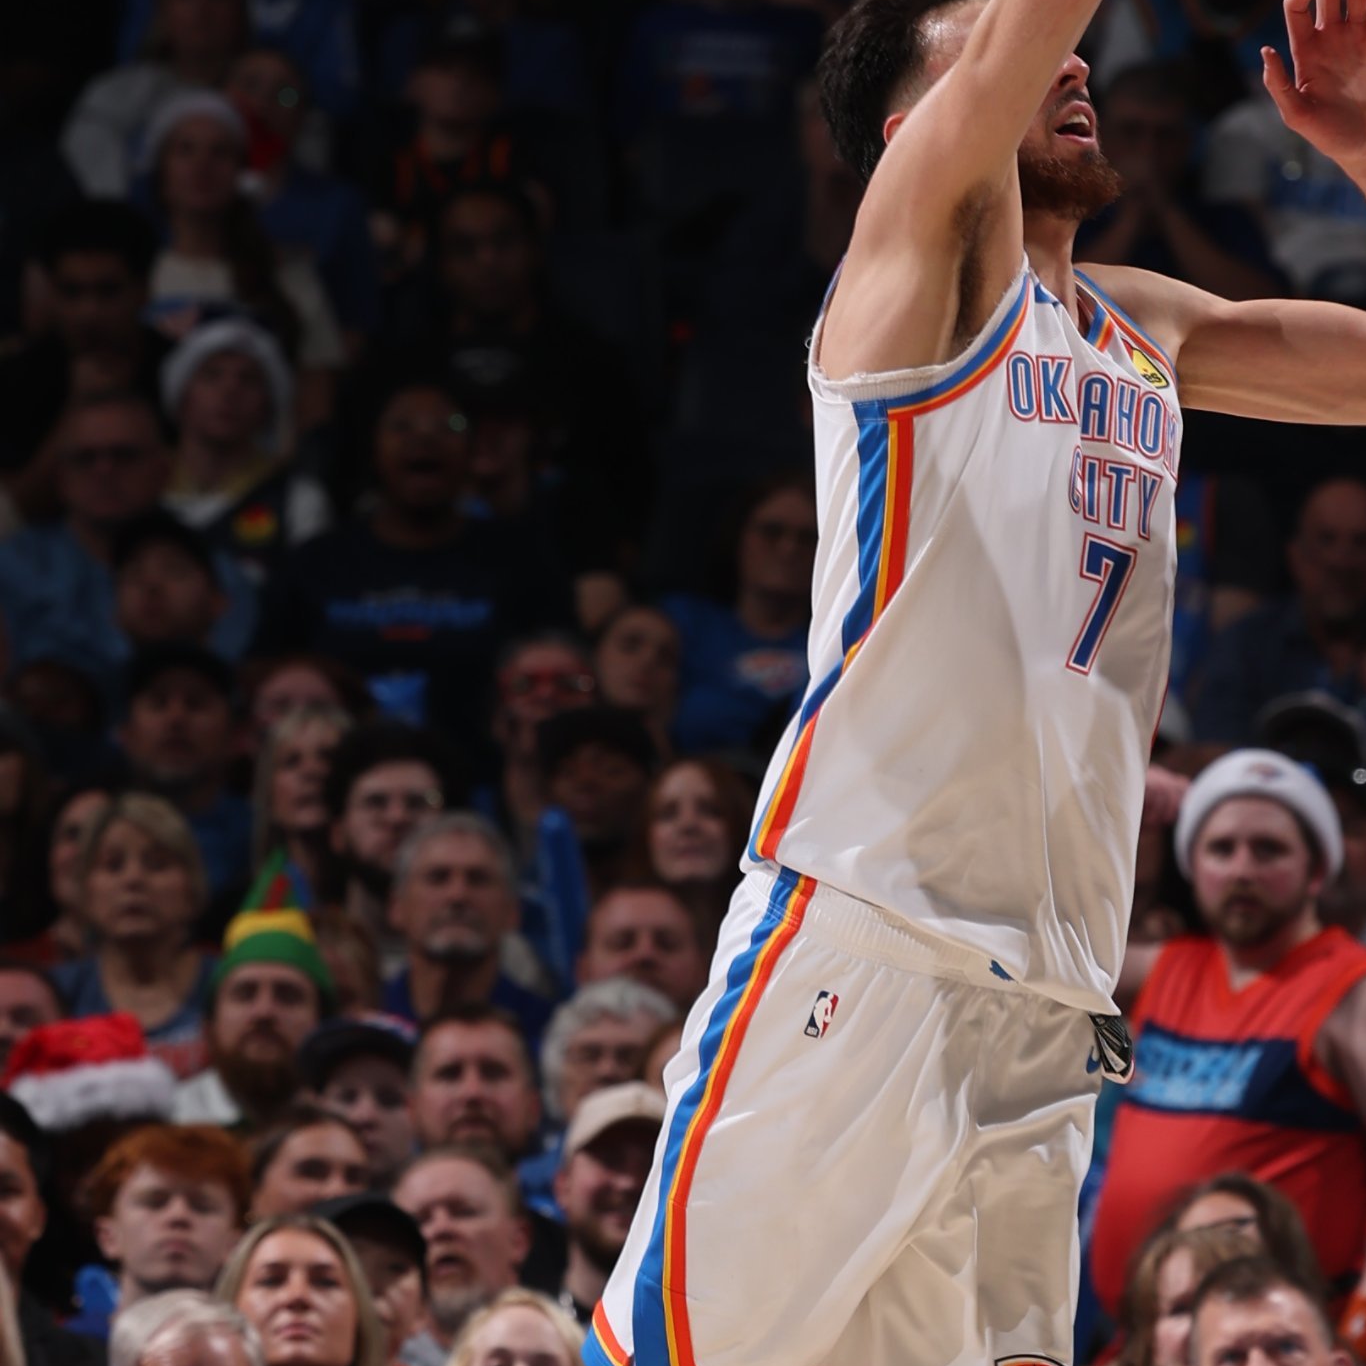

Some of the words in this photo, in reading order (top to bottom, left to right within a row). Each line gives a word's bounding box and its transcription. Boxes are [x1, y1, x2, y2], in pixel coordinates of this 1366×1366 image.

[1006, 351, 1178, 485] OKAHOM
[1069, 445, 1163, 541] CITY
[1066, 532, 1137, 675] 7
